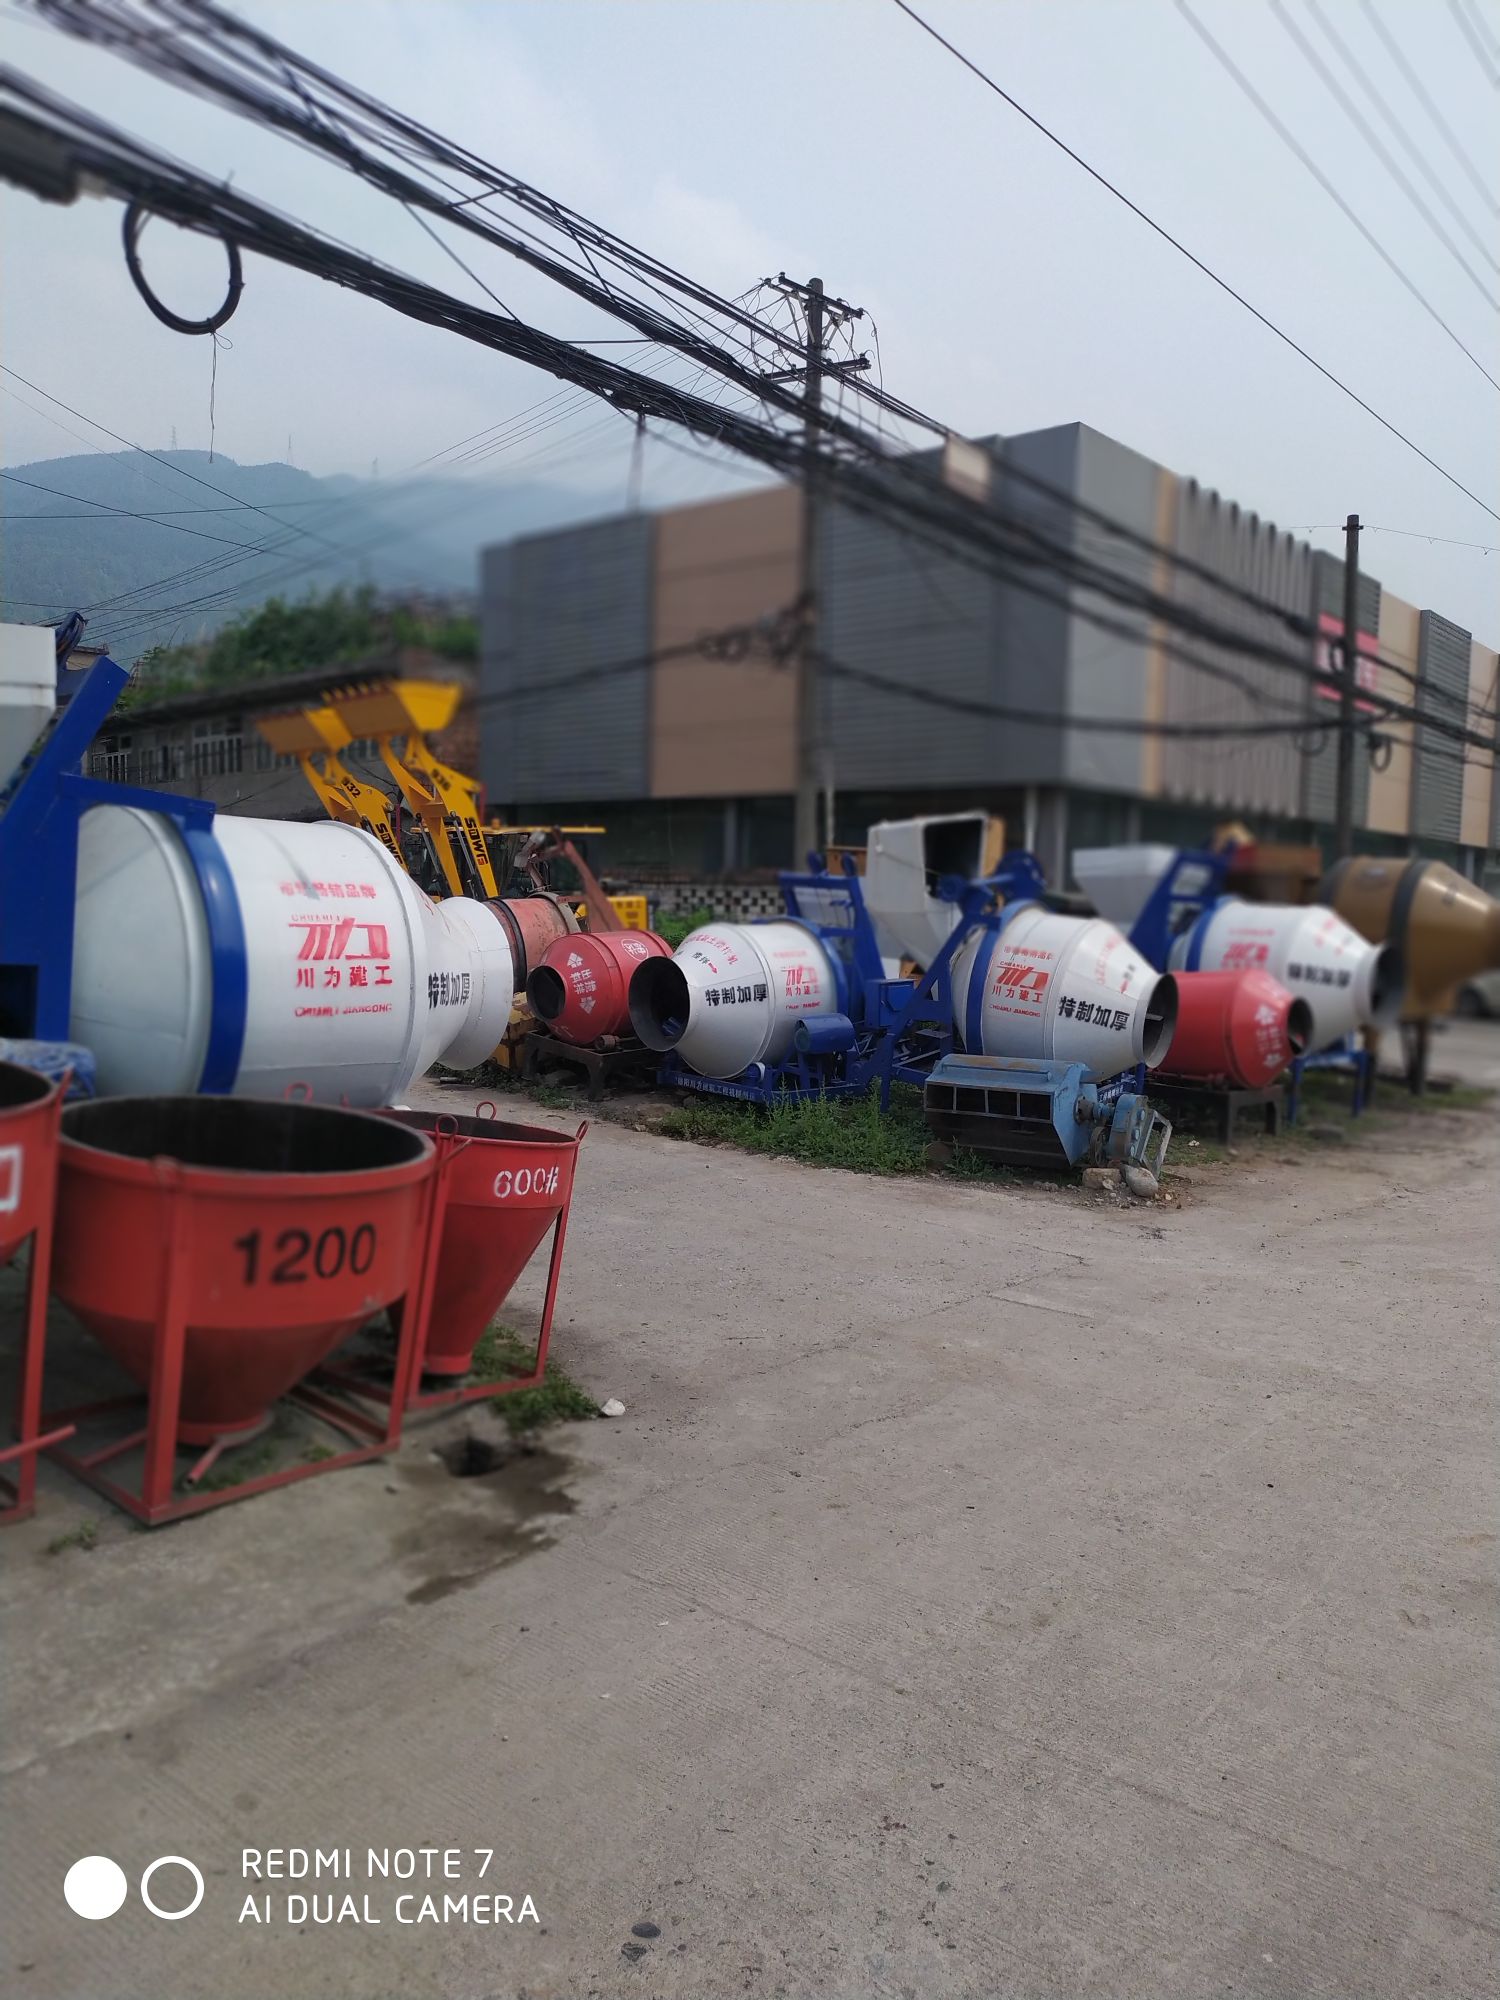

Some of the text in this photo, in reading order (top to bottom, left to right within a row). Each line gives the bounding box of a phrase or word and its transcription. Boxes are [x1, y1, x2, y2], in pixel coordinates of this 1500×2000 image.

[296, 965, 393, 989] 川力建工
[428, 971, 470, 1009] 特制加厚
[705, 983, 768, 1006] 特制加厚
[992, 984, 1043, 1003] 川力建工
[1058, 995, 1131, 1031] 特制加厚
[233, 1221, 377, 1287] 1200
